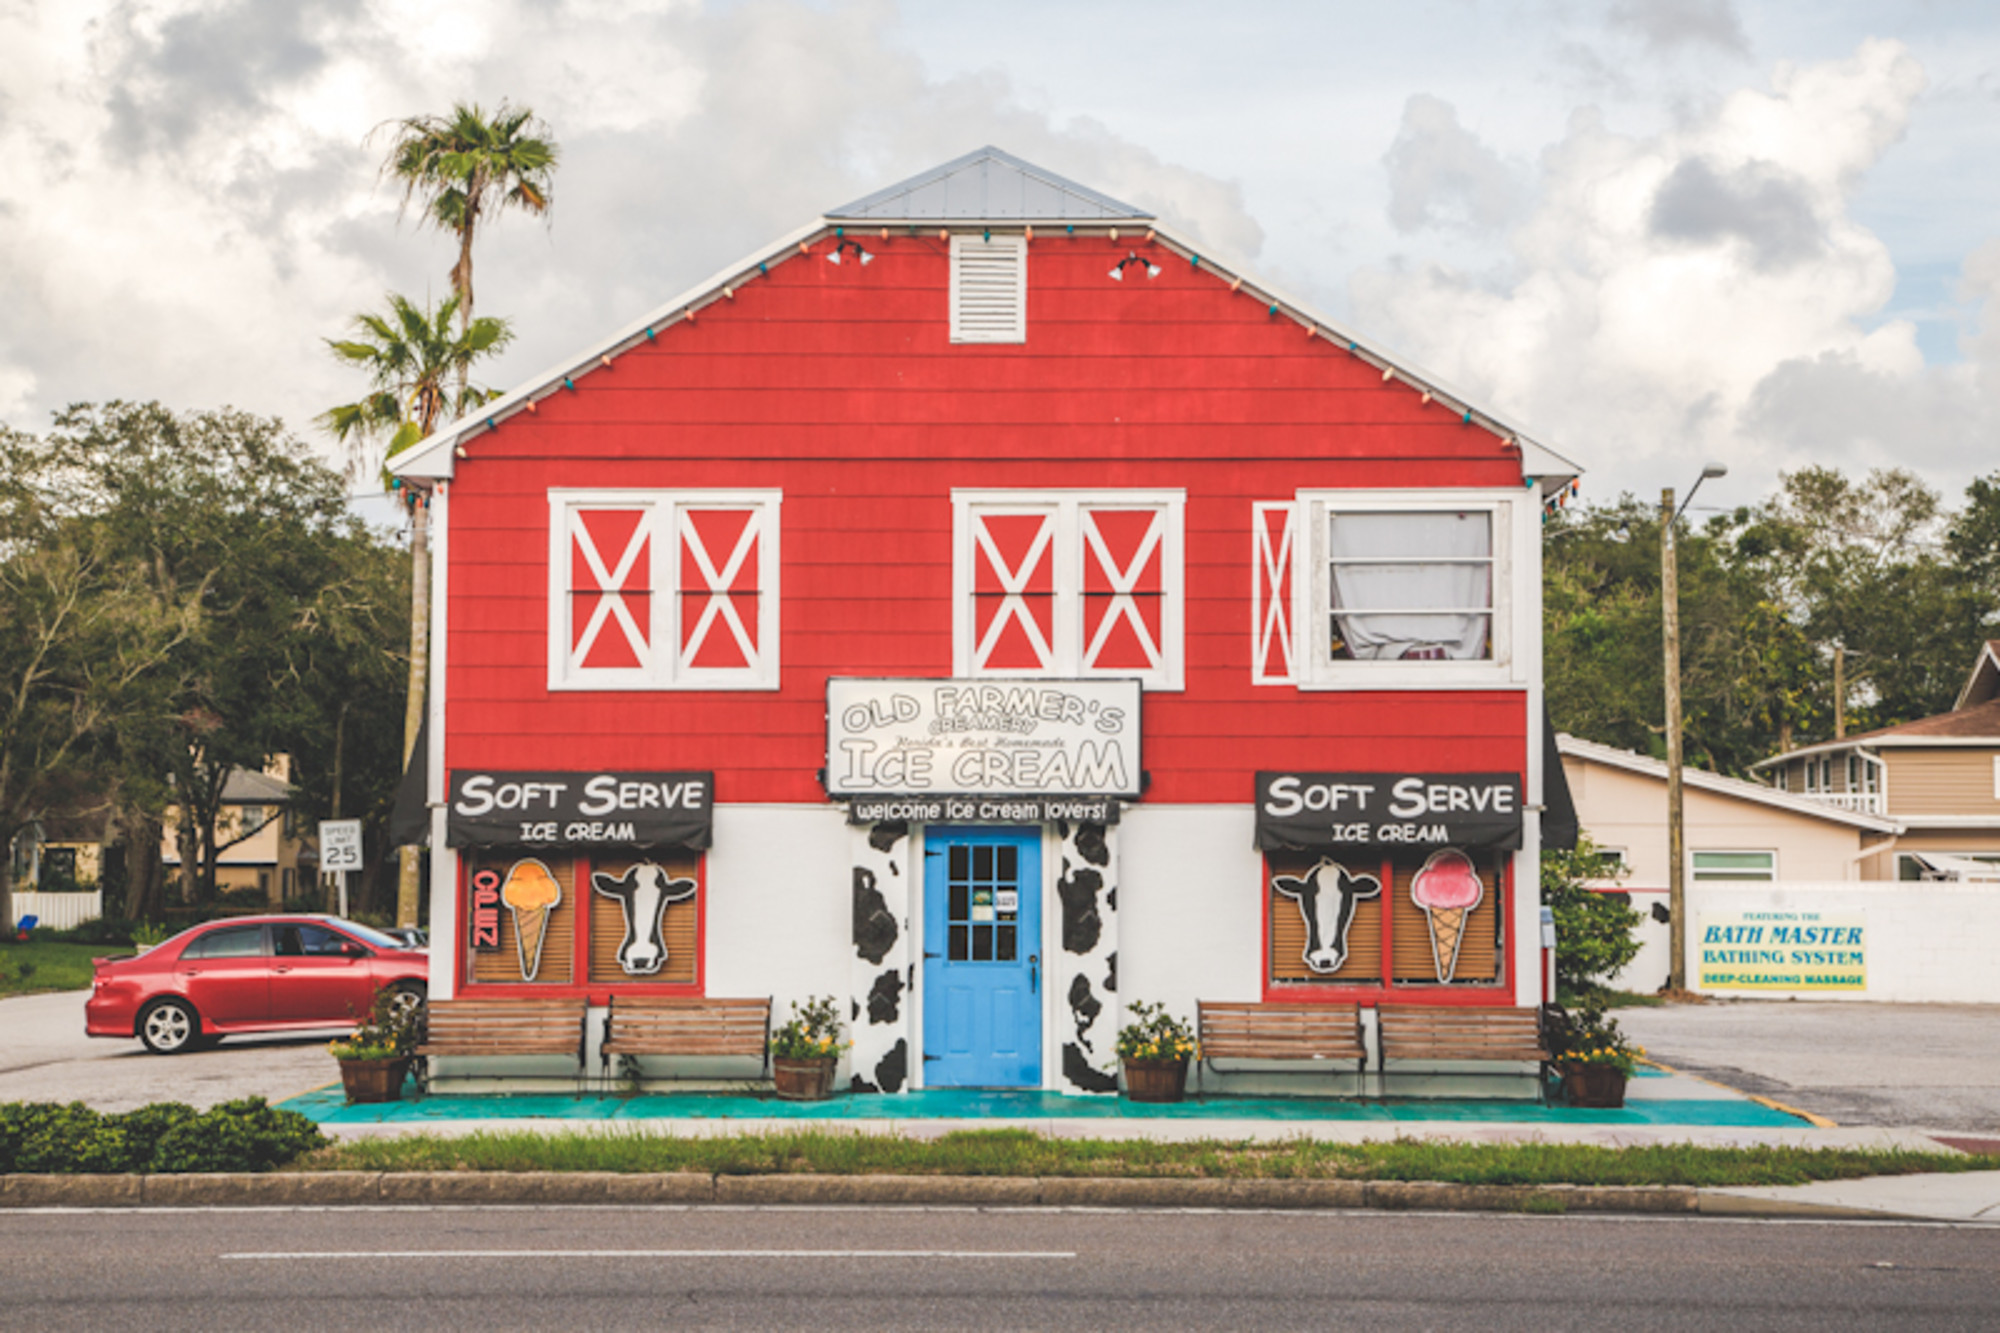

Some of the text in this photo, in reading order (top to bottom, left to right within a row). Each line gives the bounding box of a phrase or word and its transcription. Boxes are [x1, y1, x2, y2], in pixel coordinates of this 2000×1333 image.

[842, 686, 1125, 734] OLD FARMER'S
[928, 715, 1039, 736] CREAMERY
[960, 736, 989, 749] Best
[839, 738, 1129, 790] ICE CREAM
[455, 775, 705, 817] SOFT SERVE
[1264, 776, 1514, 818] SOFT SERVE
[856, 801, 941, 820] welcome
[1044, 801, 1107, 820] lovers!
[520, 823, 636, 841] ICE CREAM
[1332, 824, 1449, 842] ICE CREAM
[327, 845, 358, 865] 25
[473, 869, 500, 947] OPEN
[1742, 912, 1821, 921] FEATURING THE
[1704, 925, 1864, 945] BATH MASTER
[1703, 949, 1864, 965] BATHING SYSTEM
[1703, 973, 1864, 985] DEEP-CLEANING MASSAGE
